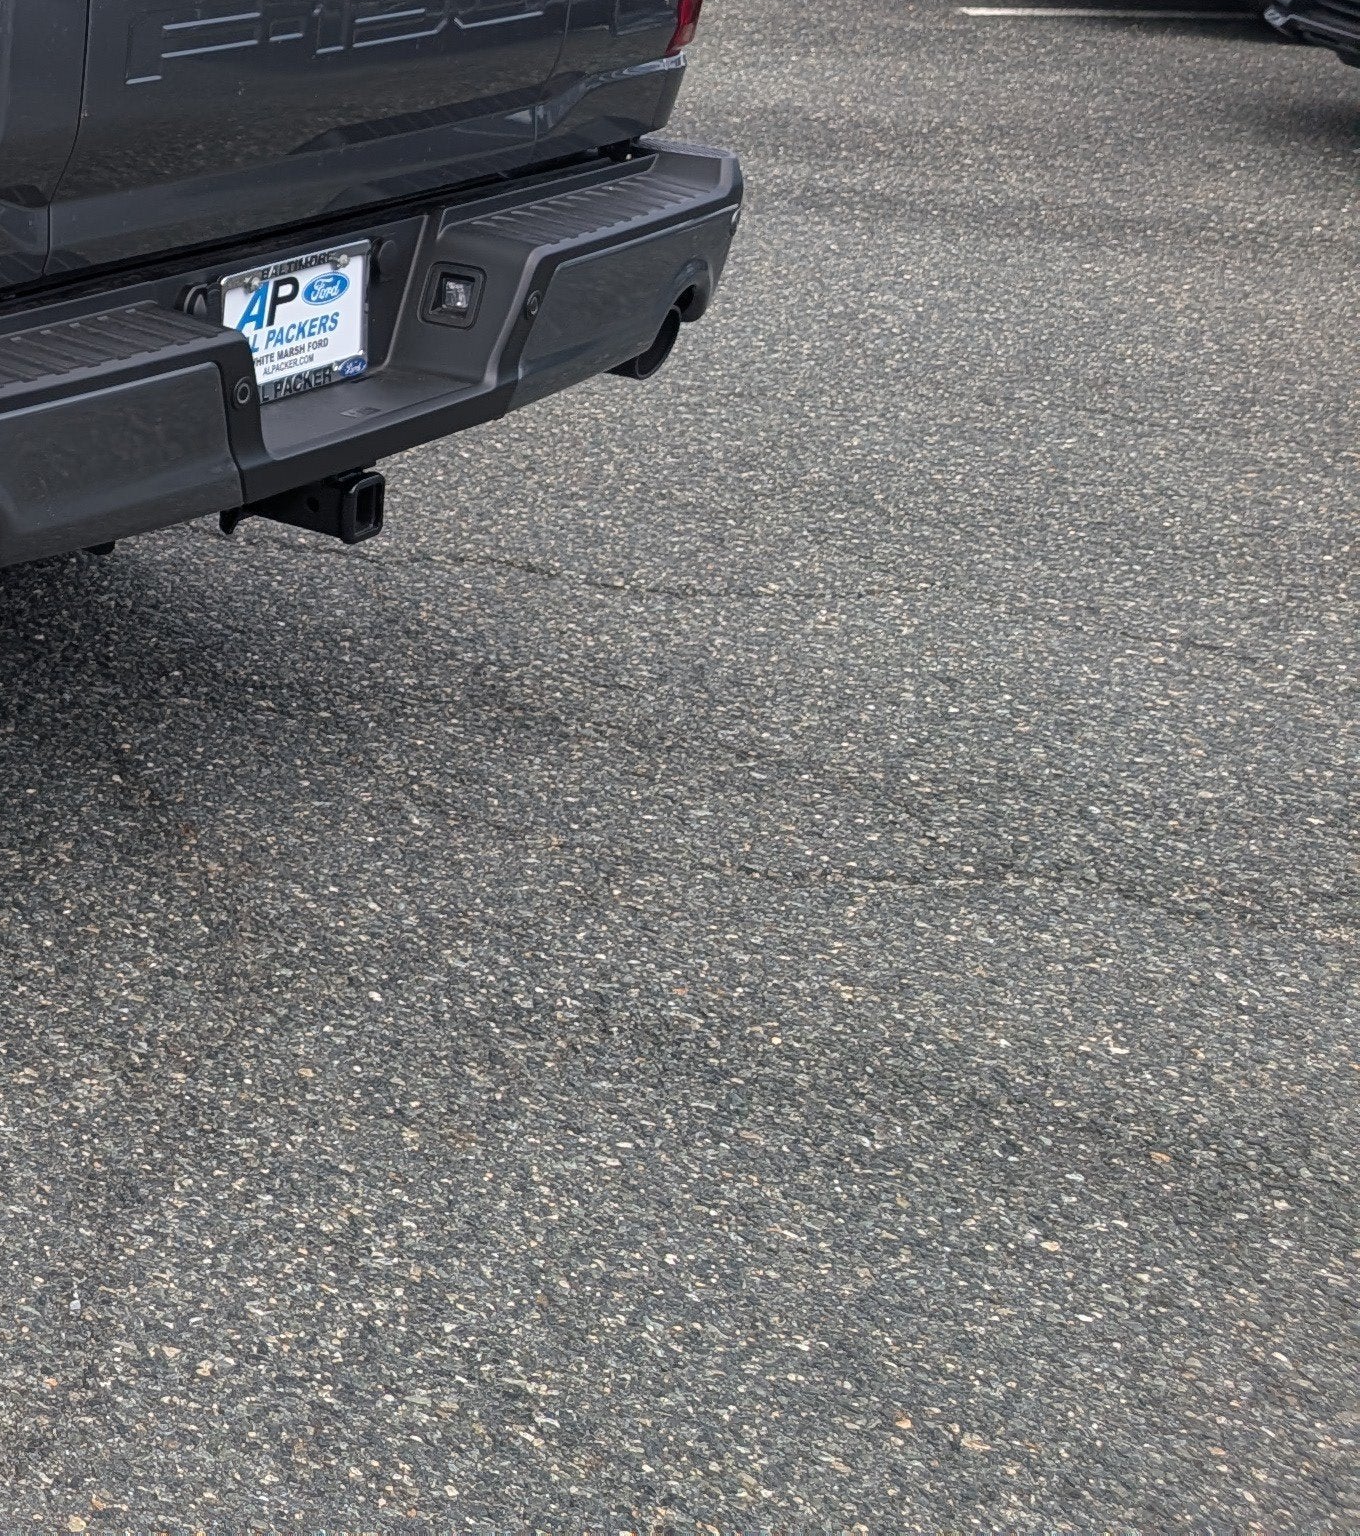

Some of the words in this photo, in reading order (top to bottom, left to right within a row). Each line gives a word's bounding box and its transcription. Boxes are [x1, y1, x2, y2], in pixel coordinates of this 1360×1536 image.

[236, 276, 300, 332] AP
[310, 277, 341, 303] Ford
[264, 311, 340, 350] PACKERS
[276, 343, 306, 361] MARSH
[307, 337, 329, 352] FORD
[273, 365, 333, 399] PACKER
